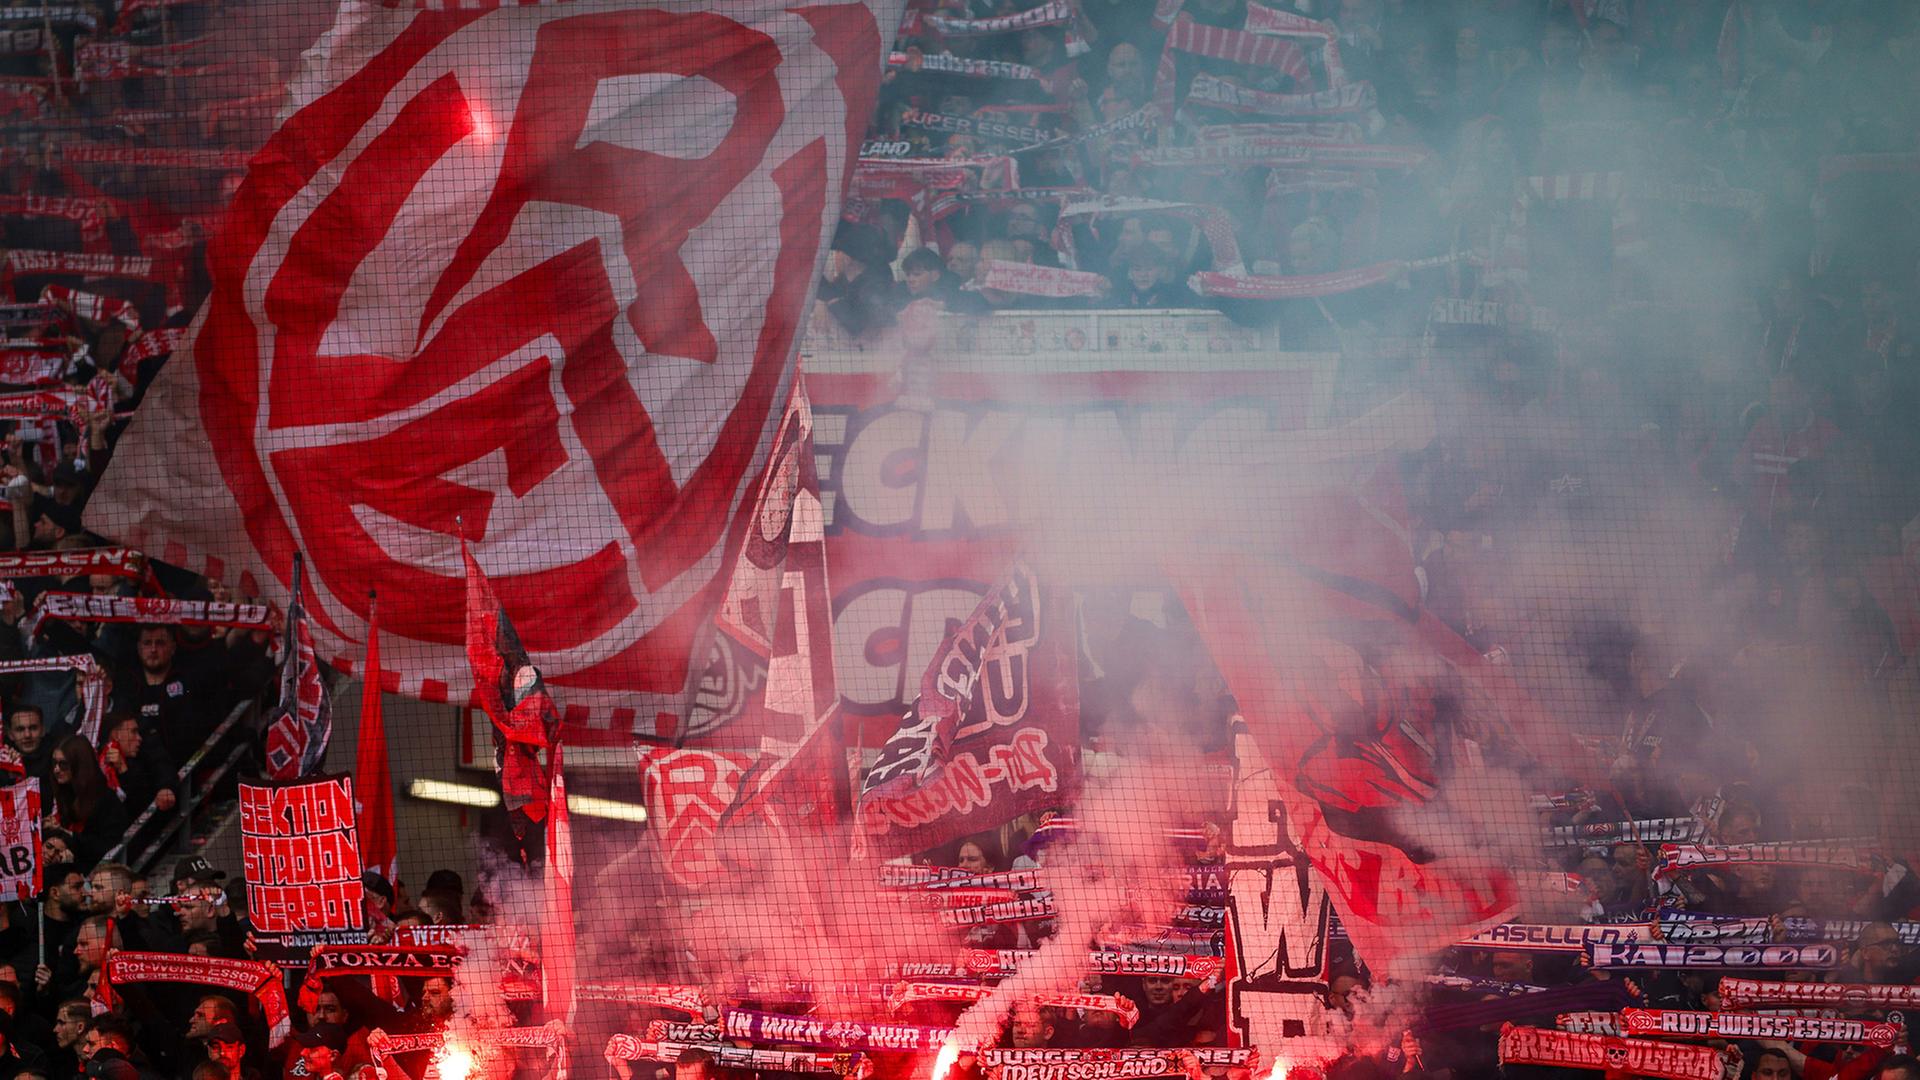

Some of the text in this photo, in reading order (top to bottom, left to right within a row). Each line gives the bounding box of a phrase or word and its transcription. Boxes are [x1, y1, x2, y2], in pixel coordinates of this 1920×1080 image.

[904, 112, 1049, 142] UPER ESSEN
[237, 776, 355, 836] SEKTION
[243, 830, 362, 886] STADION
[321, 952, 424, 969] FORZA
[902, 962, 952, 976] IMMER
[1120, 953, 1184, 974] ESSEN
[1593, 944, 1838, 968] KAI2000
[115, 961, 204, 975] Rot-Weiss
[207, 966, 260, 985] Essen
[727, 1010, 753, 1038] IN
[761, 1015, 824, 1044] WIEN
[868, 1025, 921, 1050] NUR
[1662, 1012, 1790, 1039] ROT-WEISS
[1793, 1019, 1865, 1040] ESSEN
[985, 1049, 1081, 1067] JUNGE
[1502, 1030, 1729, 1080] FREAKS ULTRAS
